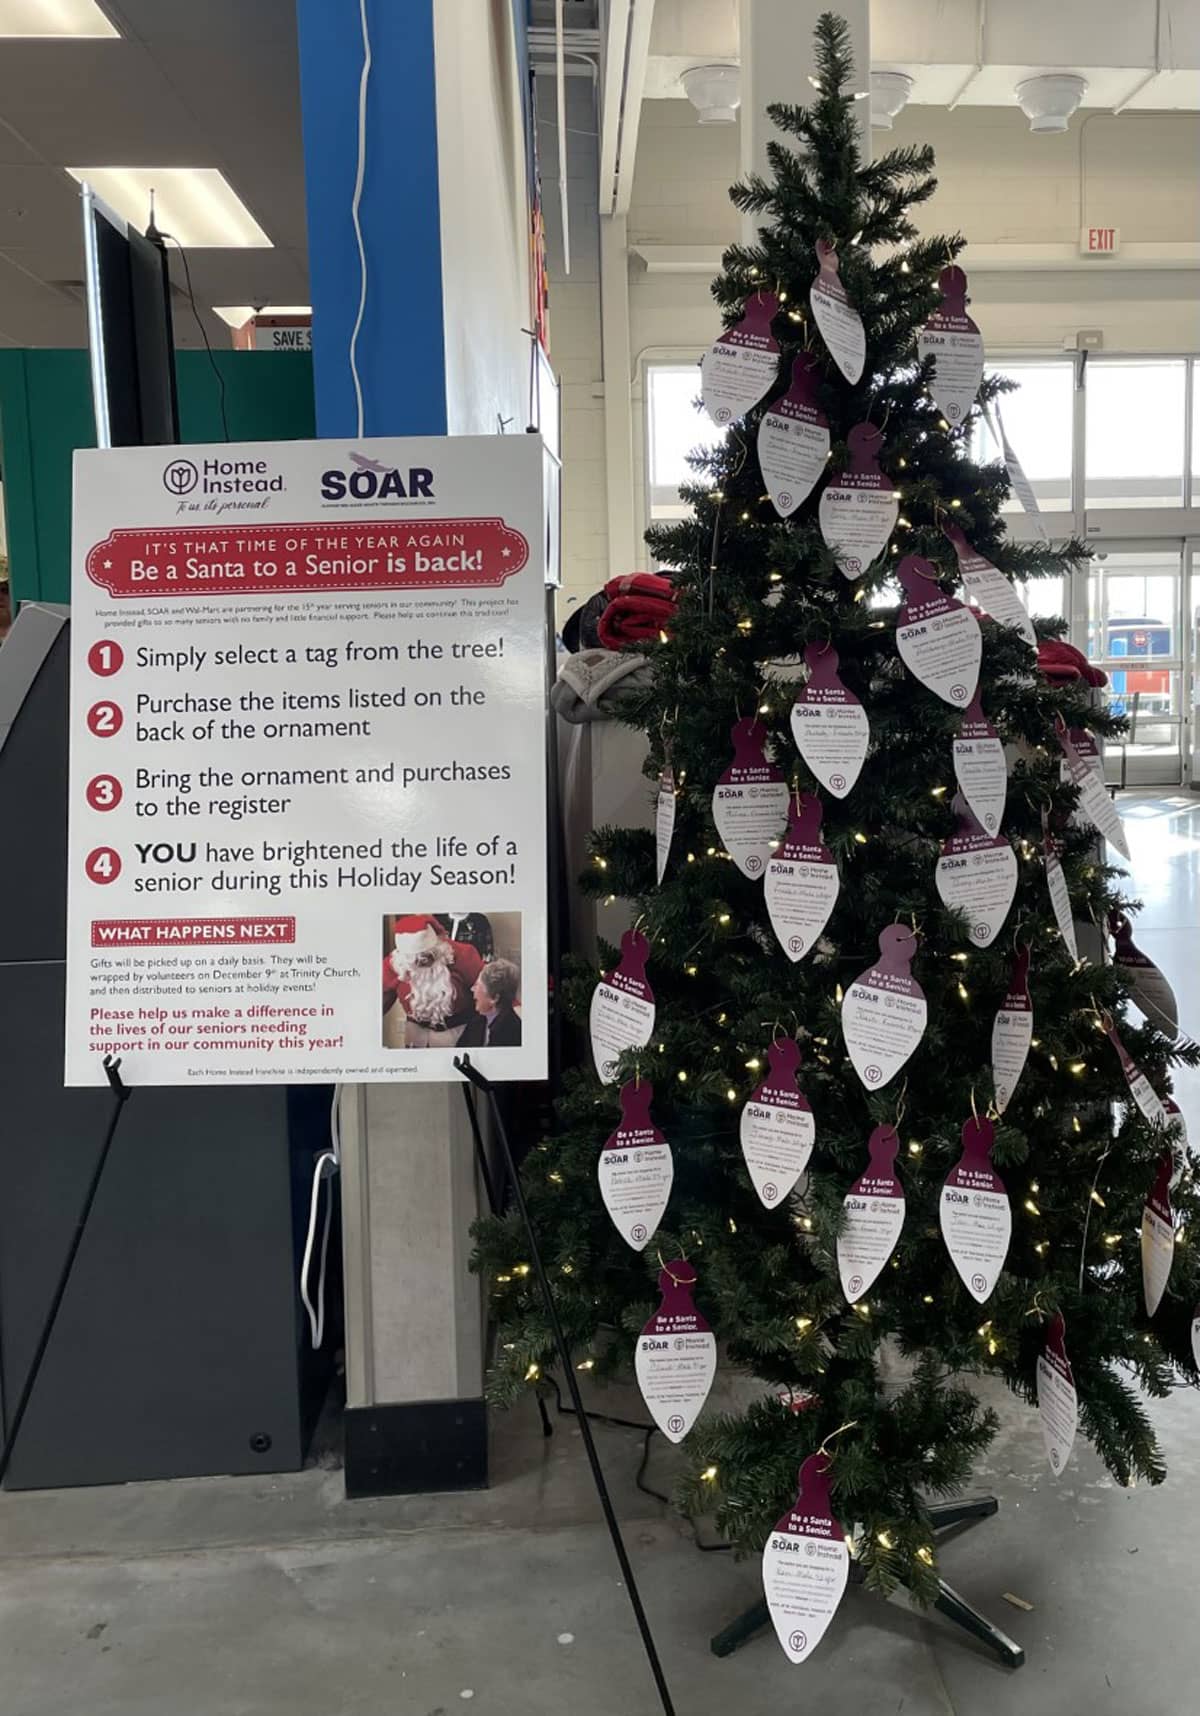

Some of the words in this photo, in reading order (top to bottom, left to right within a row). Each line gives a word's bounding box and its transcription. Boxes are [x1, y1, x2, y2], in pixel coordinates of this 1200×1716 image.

[1089, 229, 1115, 250] EXIT
[273, 331, 303, 346] SAVE
[204, 459, 267, 475] Home
[321, 468, 434, 500] SOAR
[216, 497, 270, 515] personal
[146, 543, 177, 555] IT'S
[184, 541, 229, 554] THAT
[236, 540, 276, 552] TIME
[285, 539, 307, 551] OF
[315, 537, 348, 549] THE
[355, 536, 399, 548] YEAR
[407, 534, 464, 547] AGAIN
[131, 560, 158, 580] Be
[166, 565, 178, 579] a
[186, 558, 245, 579] Santa
[253, 561, 277, 577] to
[286, 561, 297, 576] a
[306, 554, 379, 575] Senior
[388, 552, 406, 573] is
[415, 550, 482, 571] back!
[99, 645, 111, 669] 1
[137, 646, 207, 672] Simply
[215, 644, 278, 665] select
[286, 649, 297, 663] a
[305, 648, 338, 668] tag
[345, 641, 398, 660] from
[408, 639, 443, 659] the
[452, 637, 503, 658] tree!
[96, 707, 114, 730] 2
[137, 692, 232, 714] Purchase
[240, 691, 274, 711] the
[283, 691, 340, 710] items
[349, 687, 405, 708] listed
[414, 692, 441, 706] on
[450, 686, 485, 705] the
[137, 721, 185, 741] back
[192, 720, 215, 740] of
[221, 719, 255, 739] the
[263, 720, 371, 738] ornament
[96, 780, 114, 804] 3
[136, 768, 191, 794] Bring
[199, 767, 233, 787] the
[241, 769, 349, 786] ornament
[356, 763, 394, 783] and
[403, 761, 511, 788] purchases
[135, 802, 158, 816] to
[166, 797, 200, 816] the
[209, 796, 291, 820] register
[93, 853, 112, 876] 4
[135, 843, 196, 864] YOU
[206, 842, 254, 862] have
[263, 838, 382, 865] brightened
[392, 838, 427, 858] the
[437, 836, 467, 856] life
[476, 835, 500, 856] of
[506, 841, 517, 855] a
[135, 872, 203, 892] senior
[211, 870, 281, 895] during
[289, 868, 328, 889] this
[338, 866, 422, 892] Holiday
[431, 863, 515, 885] Season!
[99, 927, 151, 940] WHAT
[157, 925, 235, 939] HAPPENS
[241, 924, 288, 937] NEXT
[90, 958, 113, 968] Gifts
[115, 958, 131, 967] will
[133, 959, 145, 967] be
[148, 958, 178, 969] picked
[180, 959, 192, 968] up
[217, 956, 239, 968] daily
[270, 955, 294, 966] They
[296, 955, 313, 963] will
[316, 955, 327, 964] be
[90, 972, 130, 984] wrapped
[133, 972, 143, 983] by
[146, 971, 195, 981] volunteers
[213, 969, 261, 980] December
[290, 968, 321, 979] Trinity
[90, 987, 106, 996] and
[109, 986, 130, 995] then
[132, 985, 183, 994] distributed
[185, 986, 196, 994] to
[235, 985, 244, 993] at
[247, 983, 280, 994] holiday
[283, 982, 316, 992] events!
[91, 1008, 134, 1020] Please
[139, 1007, 168, 1022] help
[172, 1010, 187, 1018] us
[192, 1006, 230, 1018] make
[234, 1009, 242, 1017] a
[247, 1005, 317, 1017] difference
[321, 1004, 334, 1016] in
[90, 1024, 113, 1035] the
[117, 1024, 146, 1035] lives
[151, 1023, 166, 1035] of
[168, 1026, 193, 1034] our
[197, 1022, 247, 1034] seniors
[251, 1021, 307, 1035] needing
[89, 1041, 143, 1054] support
[148, 1038, 160, 1050] in
[165, 1041, 189, 1050] our
[193, 1037, 274, 1051] community
[279, 1036, 304, 1048] this
[308, 1036, 343, 1051] year!
[675, 1315, 697, 1323] Santa
[642, 1341, 669, 1351] SOAR
[788, 1523, 797, 1531] to
[791, 1513, 801, 1522] Be
[810, 1516, 832, 1526] Santa
[772, 1540, 800, 1552] SOAR
